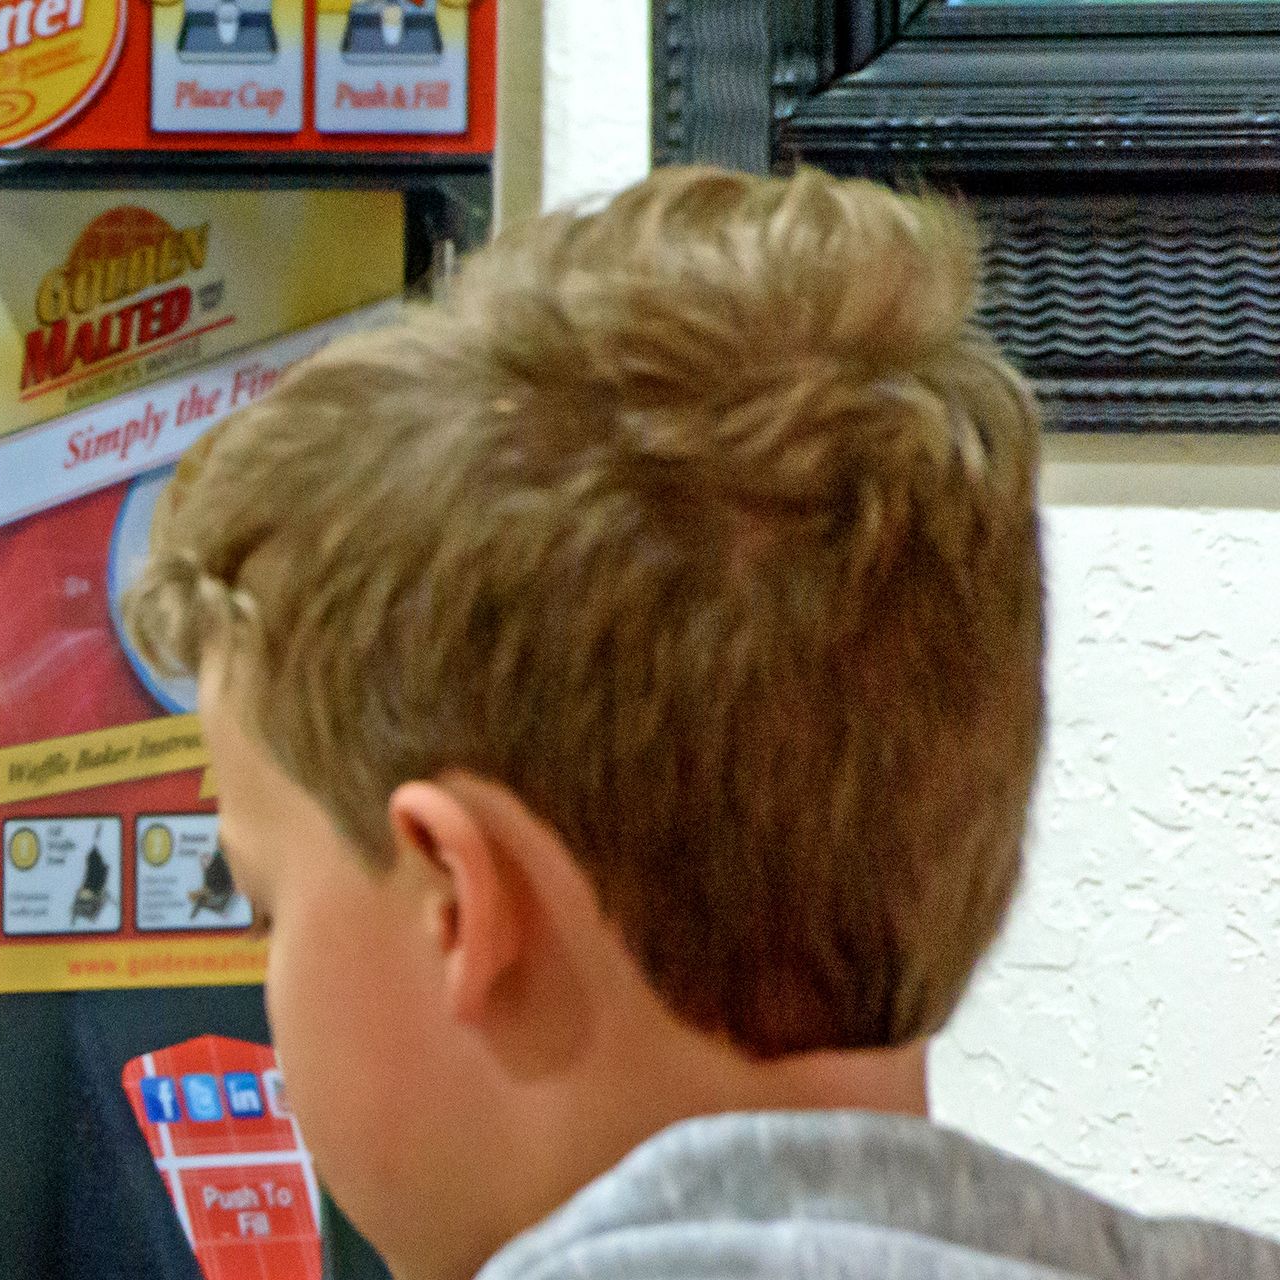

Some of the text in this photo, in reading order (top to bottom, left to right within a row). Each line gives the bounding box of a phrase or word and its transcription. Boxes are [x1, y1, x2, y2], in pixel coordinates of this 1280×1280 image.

[239, 81, 286, 117] Cup
[34, 222, 209, 325] GOLDEN
[20, 285, 192, 390] MALTED
[63, 400, 168, 470] Simply
[176, 384, 222, 428] the
[203, 1182, 293, 1210] Push To
